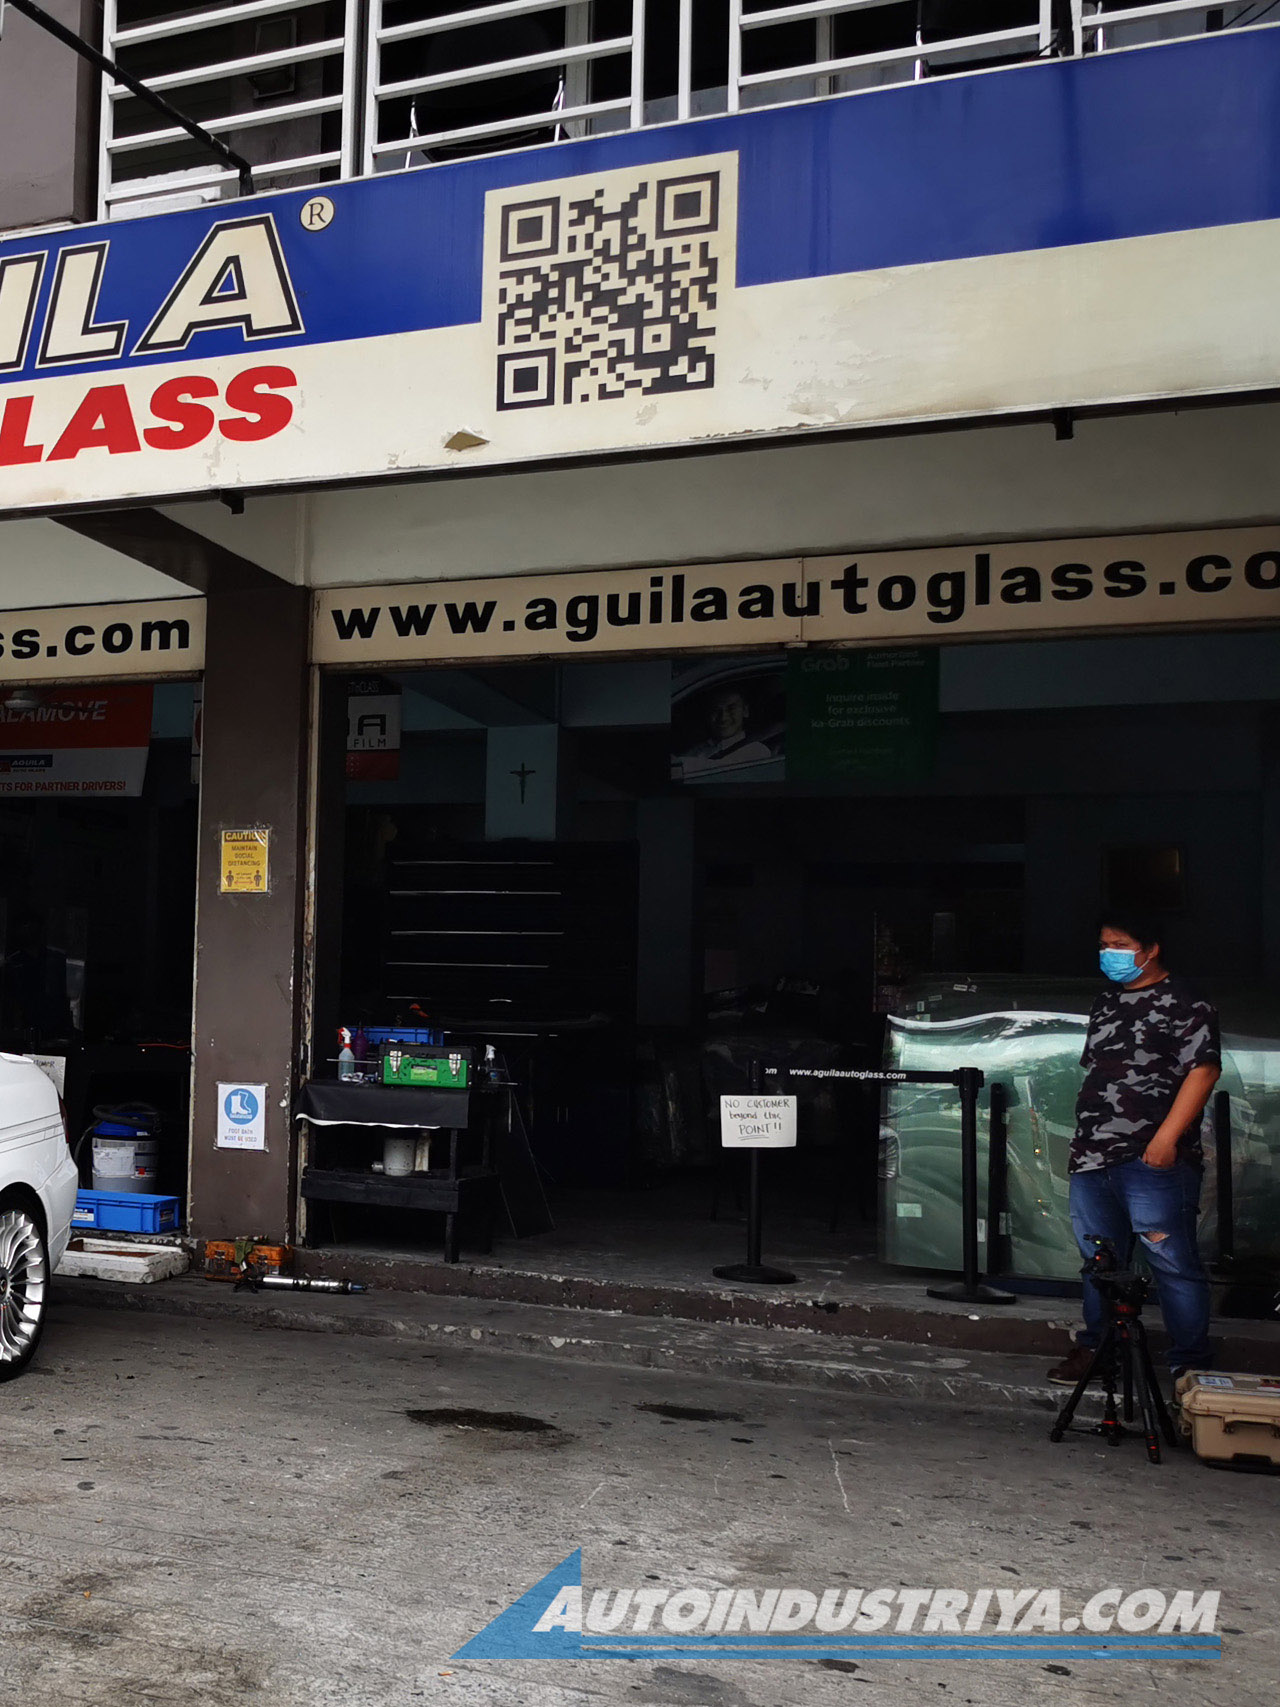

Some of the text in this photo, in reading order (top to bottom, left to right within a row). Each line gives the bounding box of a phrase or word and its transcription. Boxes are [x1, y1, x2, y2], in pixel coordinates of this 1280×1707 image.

[857, 716, 911, 727] discounts
[353, 738, 387, 749] FILM
[14, 781, 33, 792] FOR
[35, 781, 81, 792] PARTNER
[82, 780, 127, 791] DRIVERS!
[789, 1067, 907, 1080] www.aguilaautoglass.com
[724, 1098, 791, 1109] NO CUSTOMER
[729, 1111, 758, 1121] beyond
